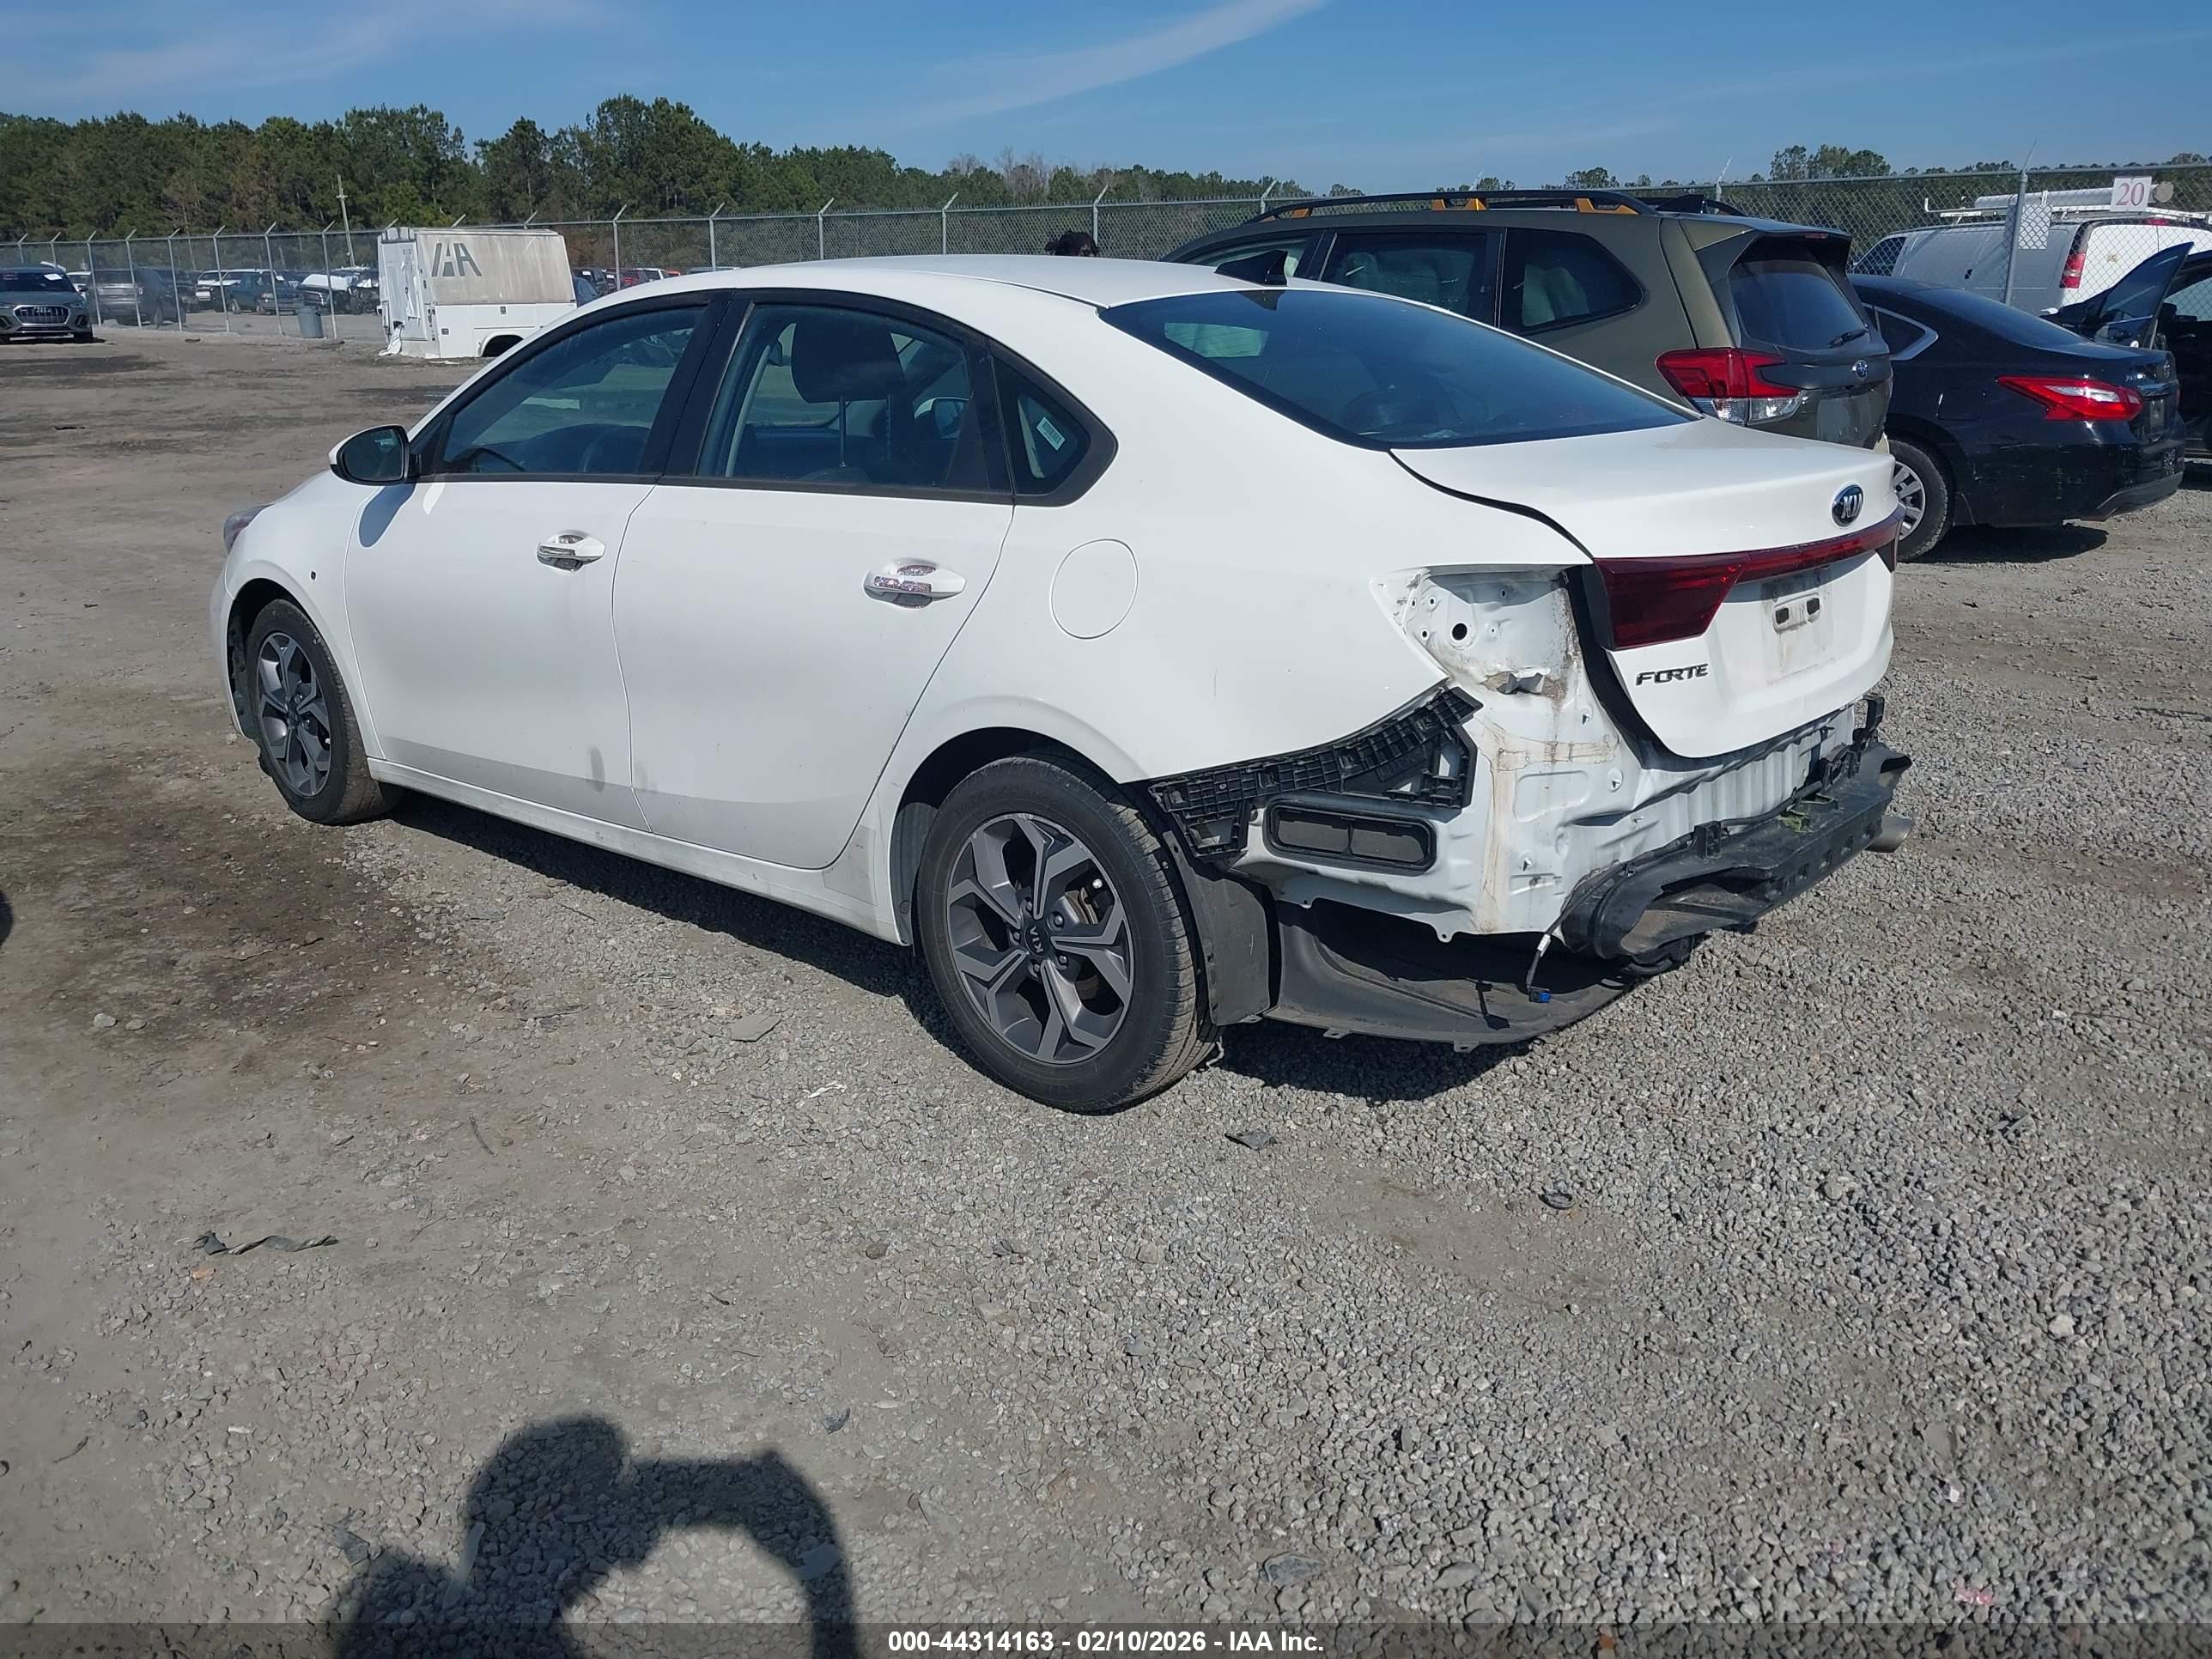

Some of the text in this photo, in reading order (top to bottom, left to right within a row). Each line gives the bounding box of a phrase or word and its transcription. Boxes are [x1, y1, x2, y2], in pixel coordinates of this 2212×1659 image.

[2116, 182, 2145, 206] 20
[1635, 663, 1709, 686] FORTE
[1030, 926, 1044, 953] KIA
